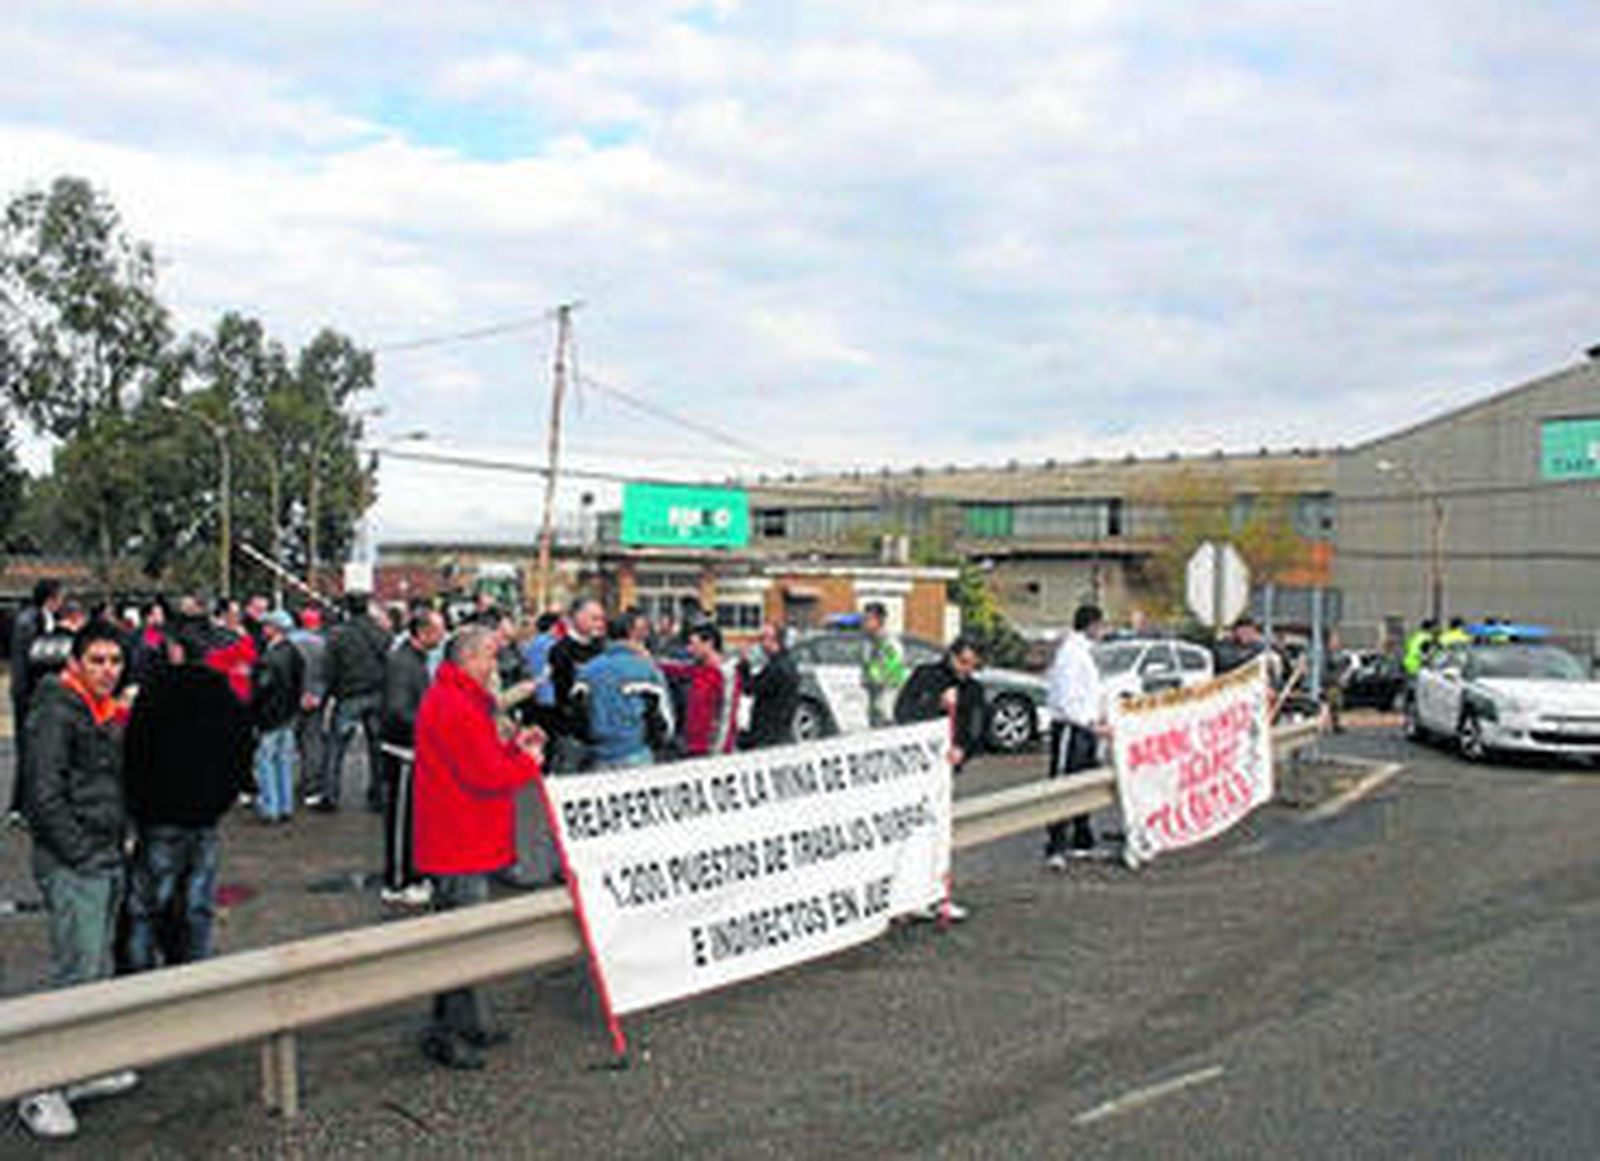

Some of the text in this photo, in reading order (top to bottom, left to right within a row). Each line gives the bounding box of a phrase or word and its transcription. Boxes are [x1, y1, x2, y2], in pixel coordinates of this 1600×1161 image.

[562, 777, 711, 840] REAPERTURA
[711, 773, 742, 814] DE
[742, 769, 768, 808] LA
[769, 762, 818, 799] MINA
[820, 754, 846, 792] DE
[847, 742, 930, 787] RIOTINTO
[602, 861, 668, 908] 1.200
[668, 839, 760, 897] PUESTOS
[763, 834, 788, 875] DE
[790, 816, 875, 869] TRABAJO
[690, 924, 707, 968] E
[707, 896, 829, 962] INDIRECTOS
[828, 887, 861, 929] EN
